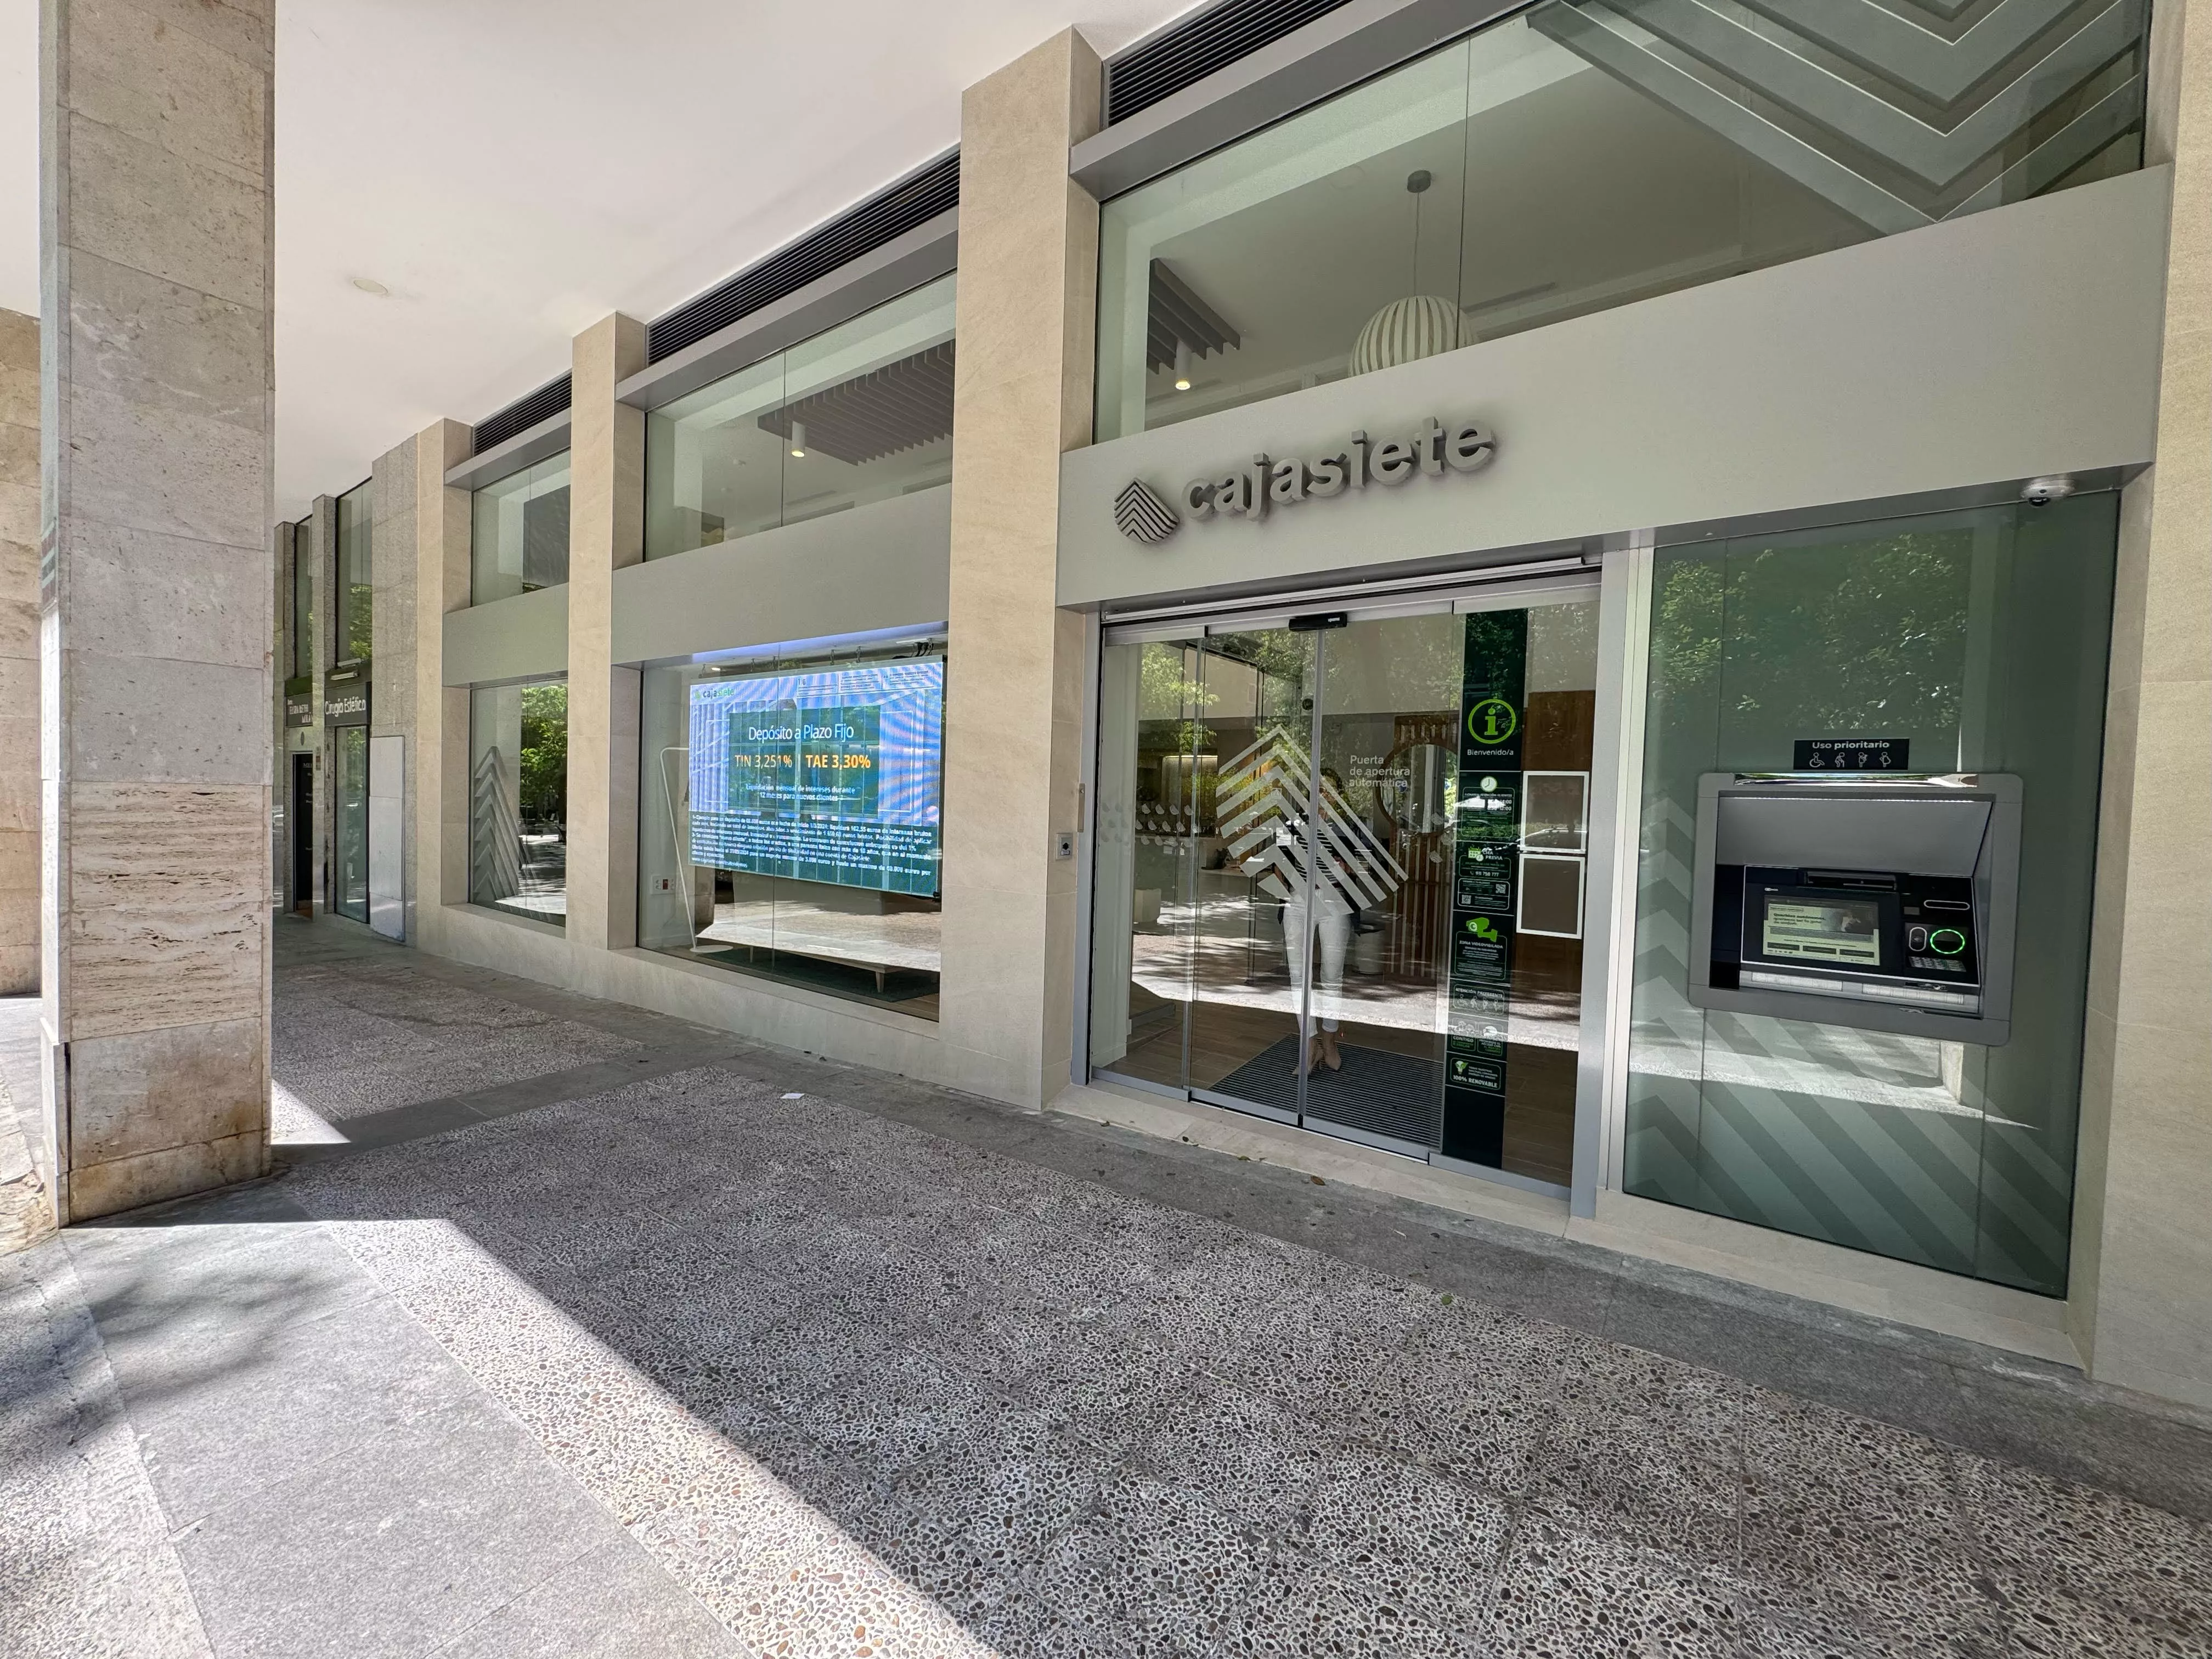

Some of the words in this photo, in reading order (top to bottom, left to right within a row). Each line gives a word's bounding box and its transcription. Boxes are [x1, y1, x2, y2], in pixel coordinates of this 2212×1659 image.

[1181, 416, 1496, 522] cajasiete
[325, 698, 343, 718] Cirugía
[344, 696, 366, 713] Estética
[748, 725, 792, 743] Depósito
[794, 731, 801, 739] a
[804, 724, 832, 739] Plazo
[835, 723, 854, 742] Fijo
[1834, 741, 1890, 750] prioritario
[735, 755, 751, 768] TIN
[805, 755, 828, 768] TAE
[832, 755, 871, 770] 3,30%
[1350, 755, 1384, 764] Puerta
[1350, 766, 1362, 776] de
[1365, 767, 1410, 777] apertura
[1350, 777, 1407, 787] automática
[832, 786, 856, 794] durante
[1468, 1077, 1498, 1088] RENOVABLE
